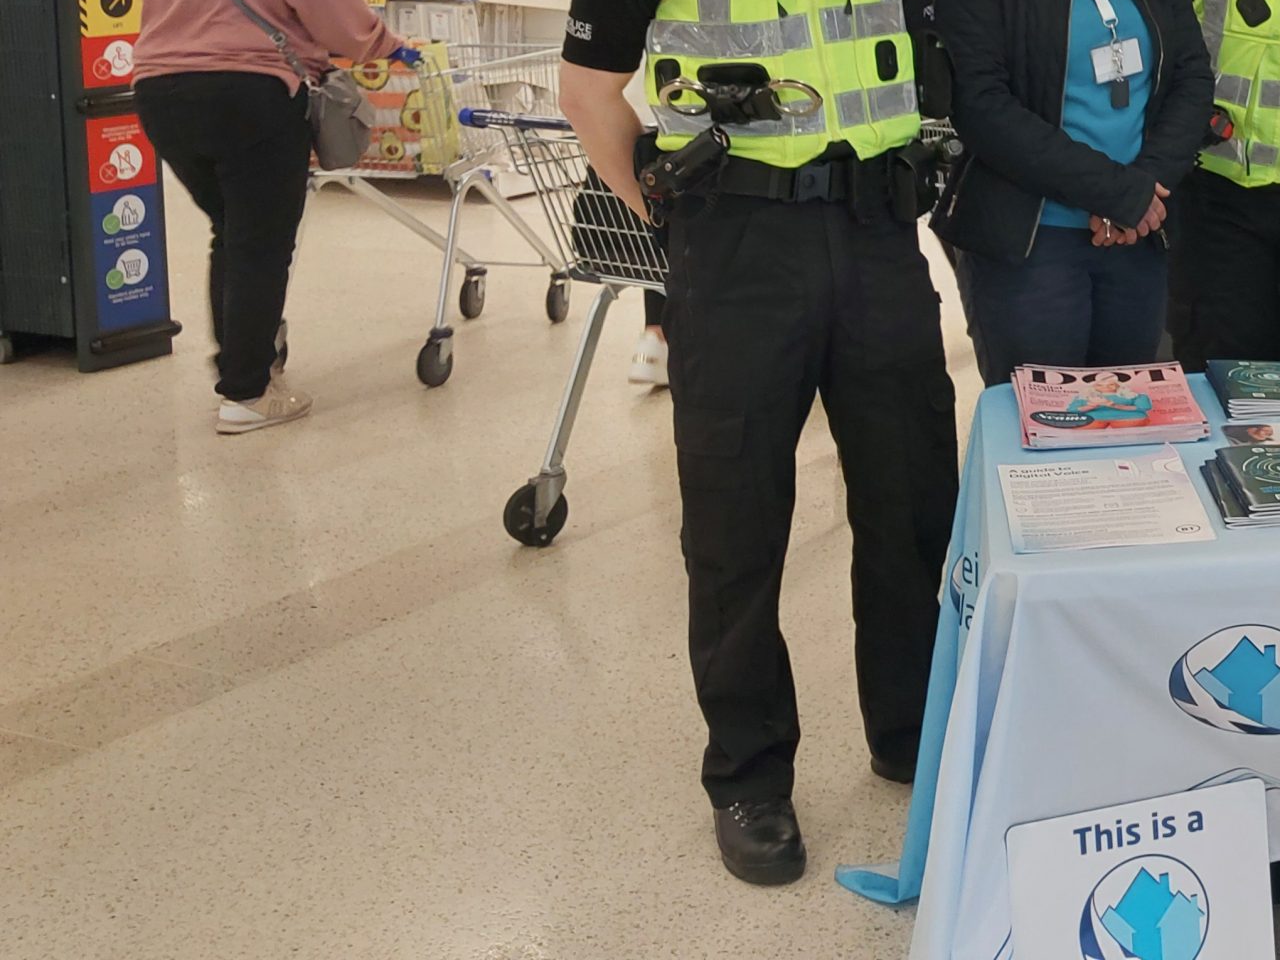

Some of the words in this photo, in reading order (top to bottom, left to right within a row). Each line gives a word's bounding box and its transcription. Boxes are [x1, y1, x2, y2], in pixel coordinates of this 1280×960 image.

[1031, 367, 1177, 385] DOT
[1073, 819, 1142, 856] This
[1151, 812, 1177, 840] is
[1187, 810, 1204, 833] a
